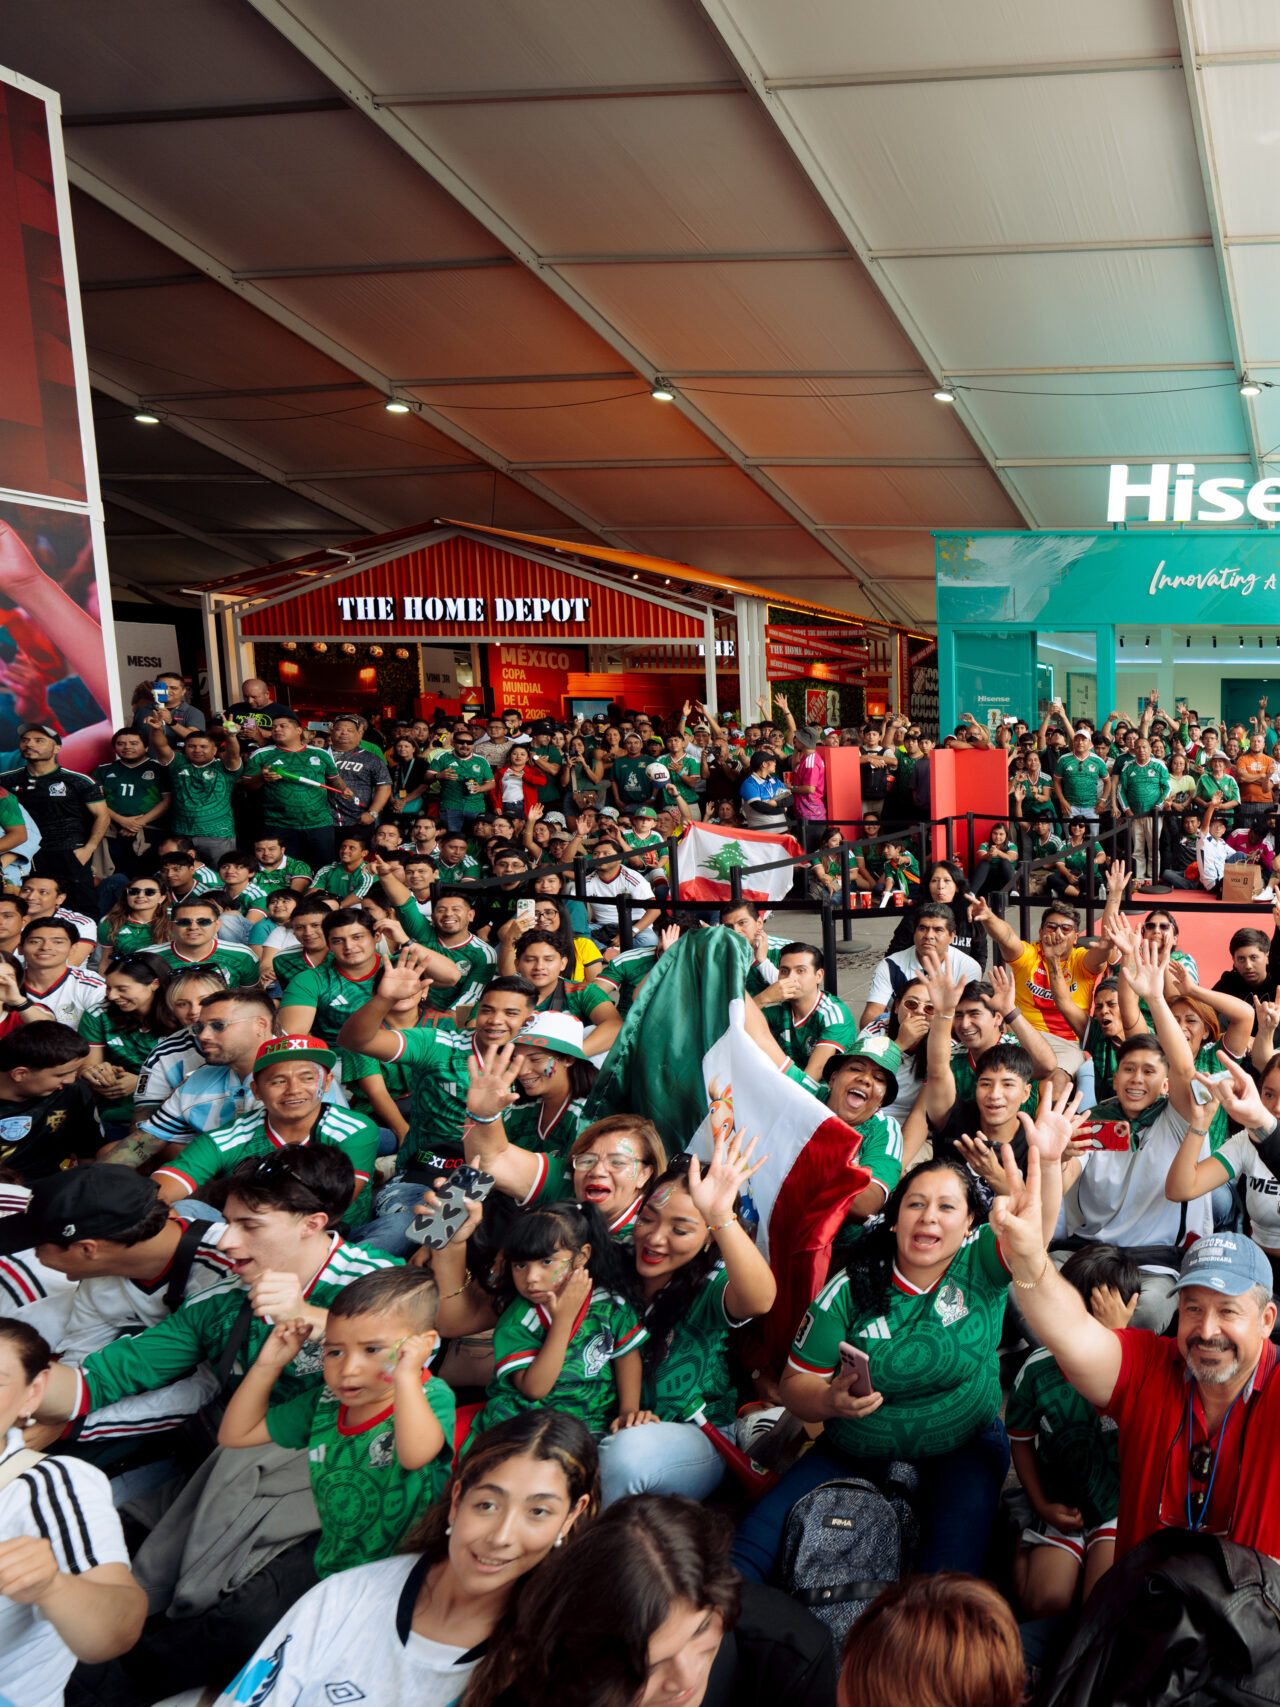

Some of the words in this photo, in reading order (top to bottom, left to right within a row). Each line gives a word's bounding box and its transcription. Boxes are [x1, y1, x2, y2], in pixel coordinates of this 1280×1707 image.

[1148, 560, 1261, 595] Innovating
[1264, 573, 1275, 589] A
[338, 596, 394, 621] THE
[403, 597, 484, 622] HOME
[494, 598, 590, 622] DEPOT
[769, 644, 784, 655] THE
[127, 655, 162, 668] MESSI
[501, 644, 570, 671] MÉXICO
[426, 674, 441, 684] VINI
[502, 668, 527, 680] COPA
[502, 681, 544, 695] MUNDIAL
[504, 695, 517, 706] DE
[518, 695, 530, 707] LA
[807, 693, 827, 724] HOME
[121, 784, 135, 796] 11
[951, 935, 972, 948] ORK
[1215, 1238, 1238, 1251] PLATA
